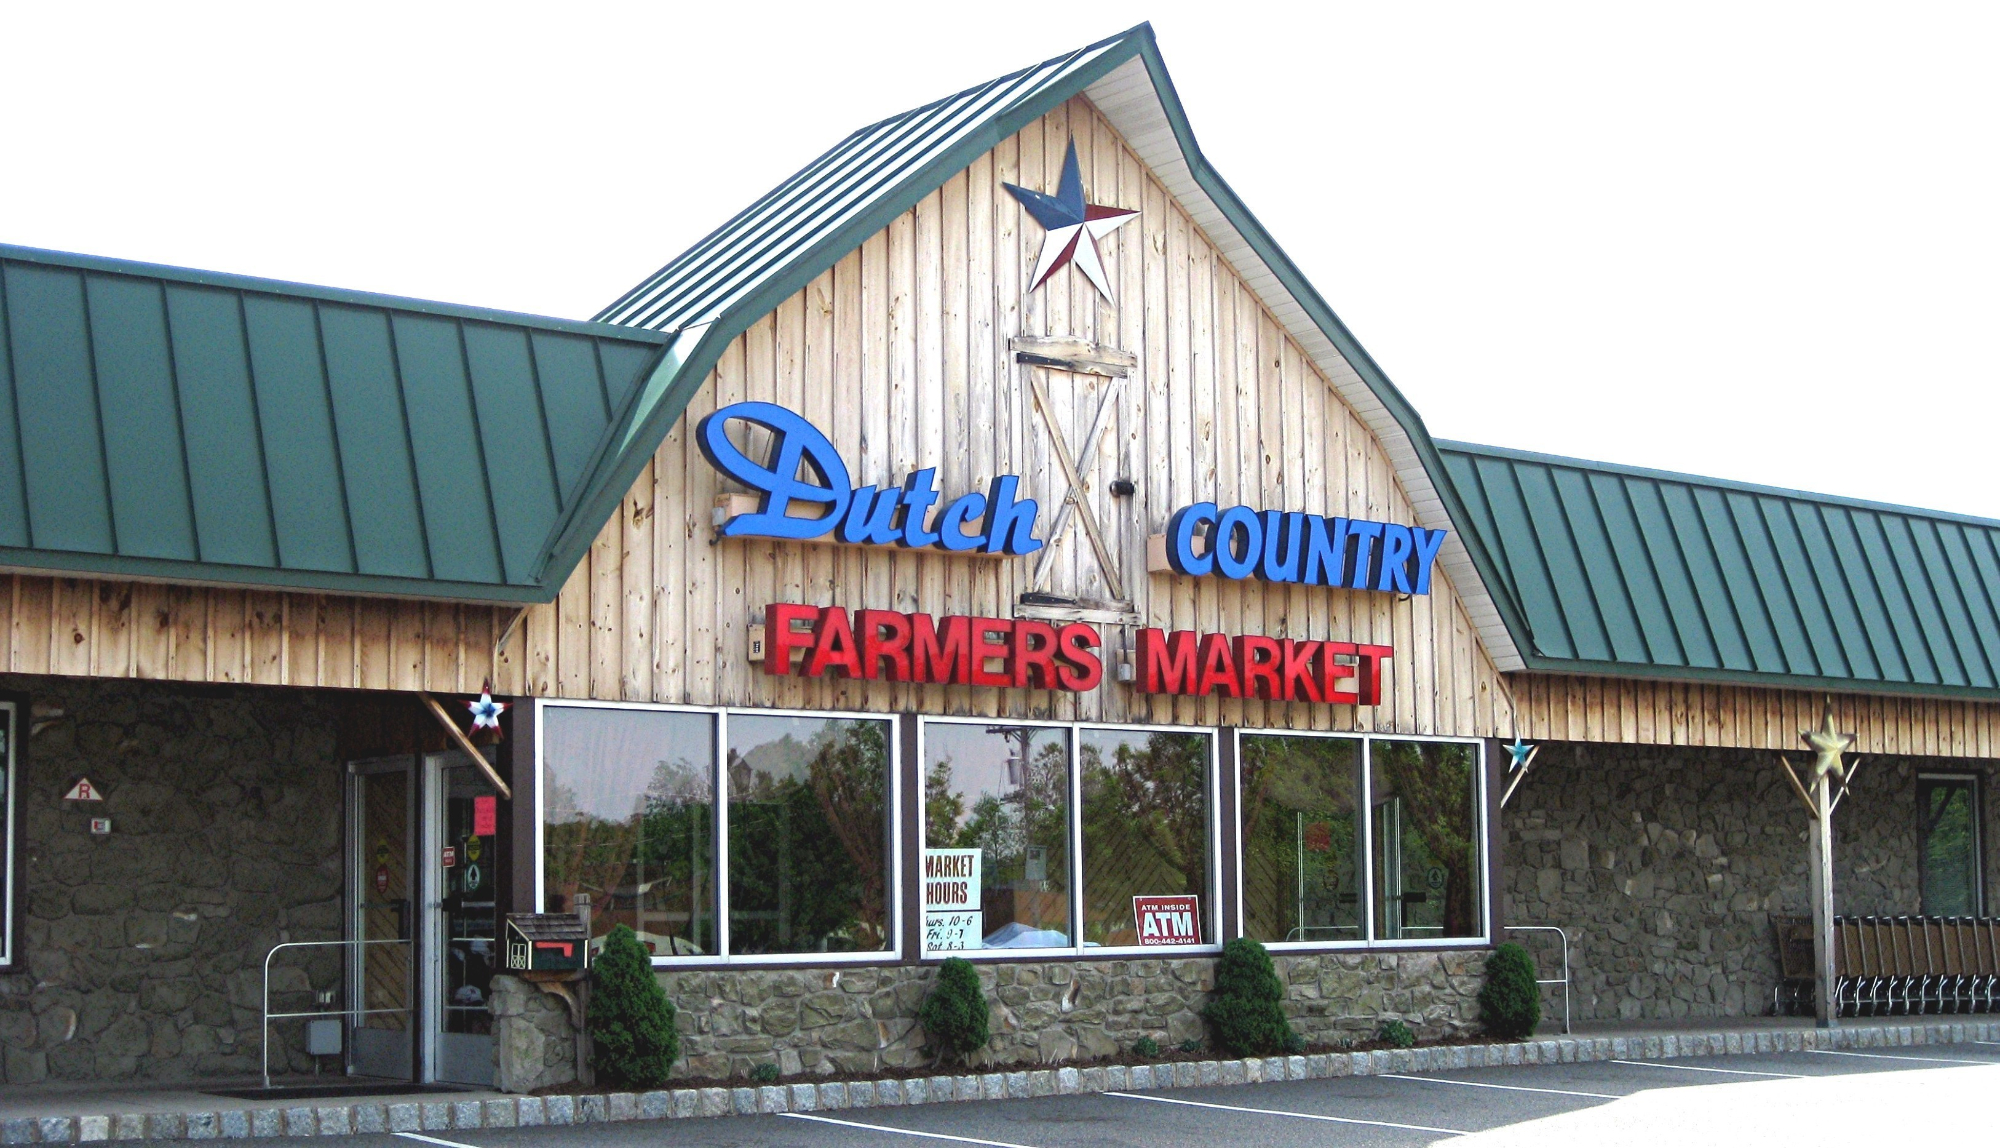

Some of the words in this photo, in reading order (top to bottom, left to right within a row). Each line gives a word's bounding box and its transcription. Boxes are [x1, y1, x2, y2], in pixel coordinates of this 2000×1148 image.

[697, 401, 1043, 555] Dutch
[1166, 501, 1447, 595] COUNTRY
[765, 603, 1102, 692] FARMERS
[1136, 628, 1394, 706] MARKET
[79, 783, 90, 799] R
[926, 881, 968, 905] HOURS
[1143, 912, 1194, 937] ATM
